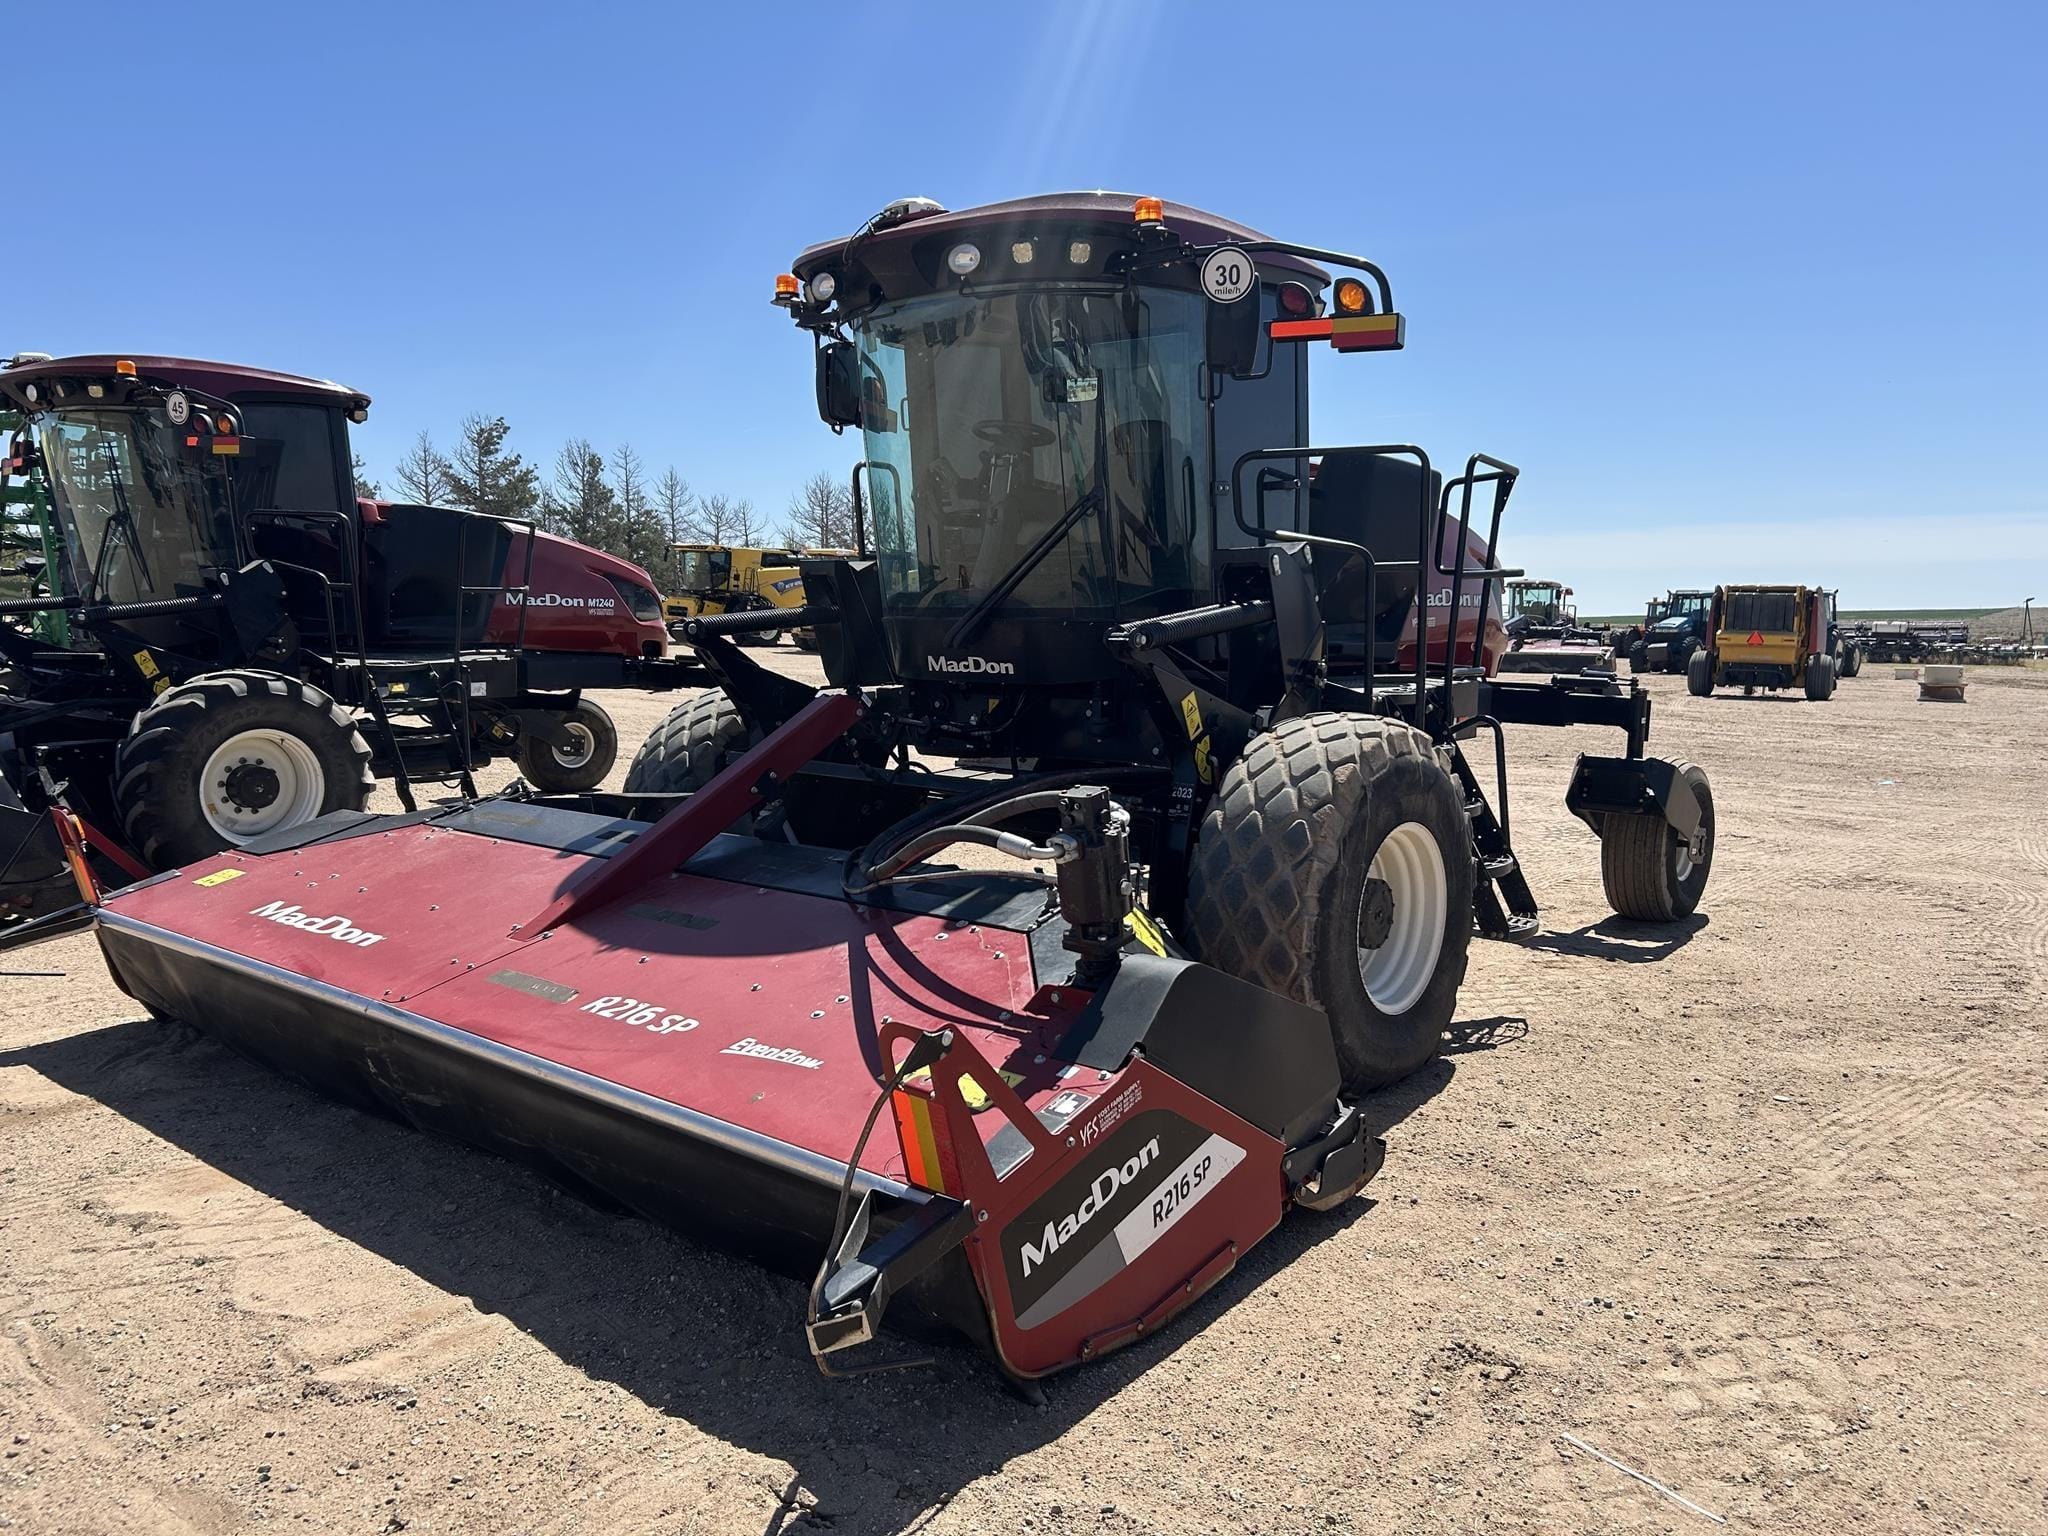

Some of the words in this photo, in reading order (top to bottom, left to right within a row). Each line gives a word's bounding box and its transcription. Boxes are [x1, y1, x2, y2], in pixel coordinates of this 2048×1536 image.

[1215, 264, 1240, 286] 30
[1214, 286, 1241, 295] mile/h
[172, 402, 184, 414] 45
[506, 592, 584, 607] MacDon
[587, 598, 615, 608] M1240
[927, 655, 1015, 675] MacDon
[1172, 787, 1193, 799] 2023
[249, 900, 387, 947] MacDon
[579, 996, 666, 1026] R216
[646, 1014, 700, 1035] SP
[722, 1037, 825, 1069] EvenFlow
[1080, 1116, 1099, 1147] YFS
[1152, 1175, 1192, 1229] R216
[1193, 1155, 1212, 1188] SP
[1020, 1137, 1161, 1278] MacDon
